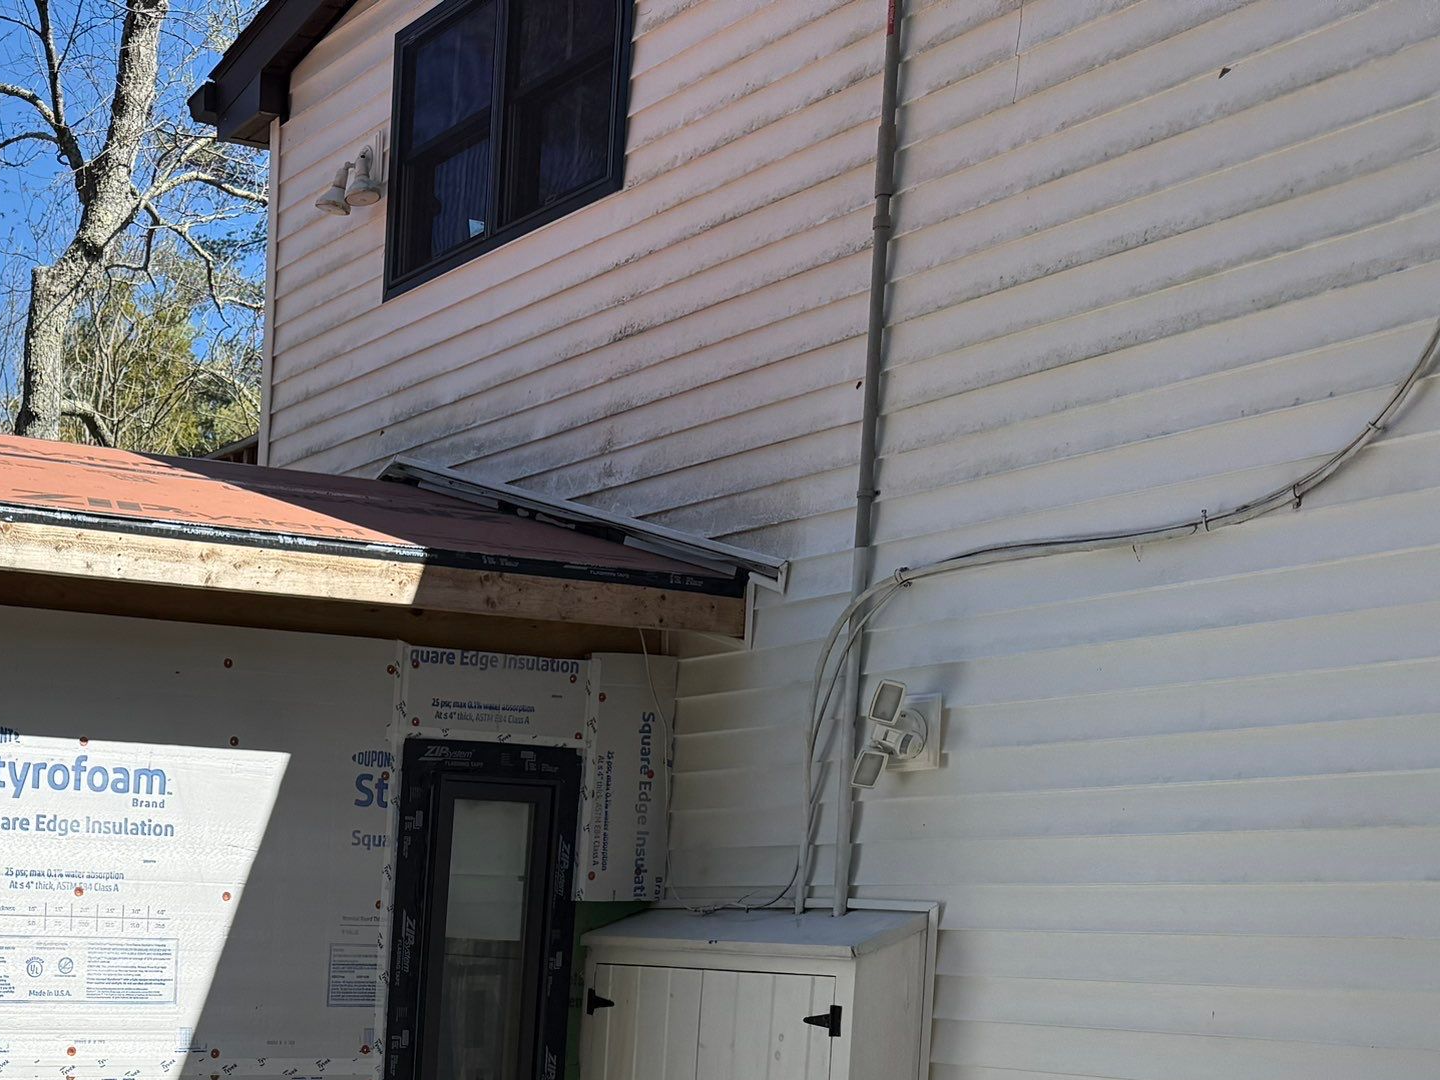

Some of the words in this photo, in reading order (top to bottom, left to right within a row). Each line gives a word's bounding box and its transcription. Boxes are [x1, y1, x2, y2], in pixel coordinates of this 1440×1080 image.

[183, 528, 213, 537] FLASHING
[214, 530, 231, 539] TAPE
[460, 650, 499, 671] Edge
[502, 655, 580, 674] Insulation
[432, 698, 439, 707] 25
[483, 703, 500, 711] water
[501, 704, 535, 713] absorption
[457, 712, 475, 722] thick,
[475, 713, 494, 722] ASTM
[508, 715, 522, 724] Class
[639, 711, 655, 776] Square
[132, 797, 165, 809] Brand
[635, 780, 652, 826] Edge
[35, 813, 81, 836] Edge
[85, 816, 175, 837] Insulation
[5, 867, 14, 876] 25
[29, 869, 45, 877] max
[64, 870, 85, 879] water
[86, 871, 125, 881] absorption
[9, 881, 18, 889] At
[35, 881, 55, 891] thick,
[56, 882, 77, 891] ASTM
[95, 883, 112, 892] Class
[113, 884, 120, 892] A
[60, 1063, 77, 1076] Tyvek
[222, 1063, 238, 1075] Tyvek
[315, 1058, 331, 1072] Tyvek
